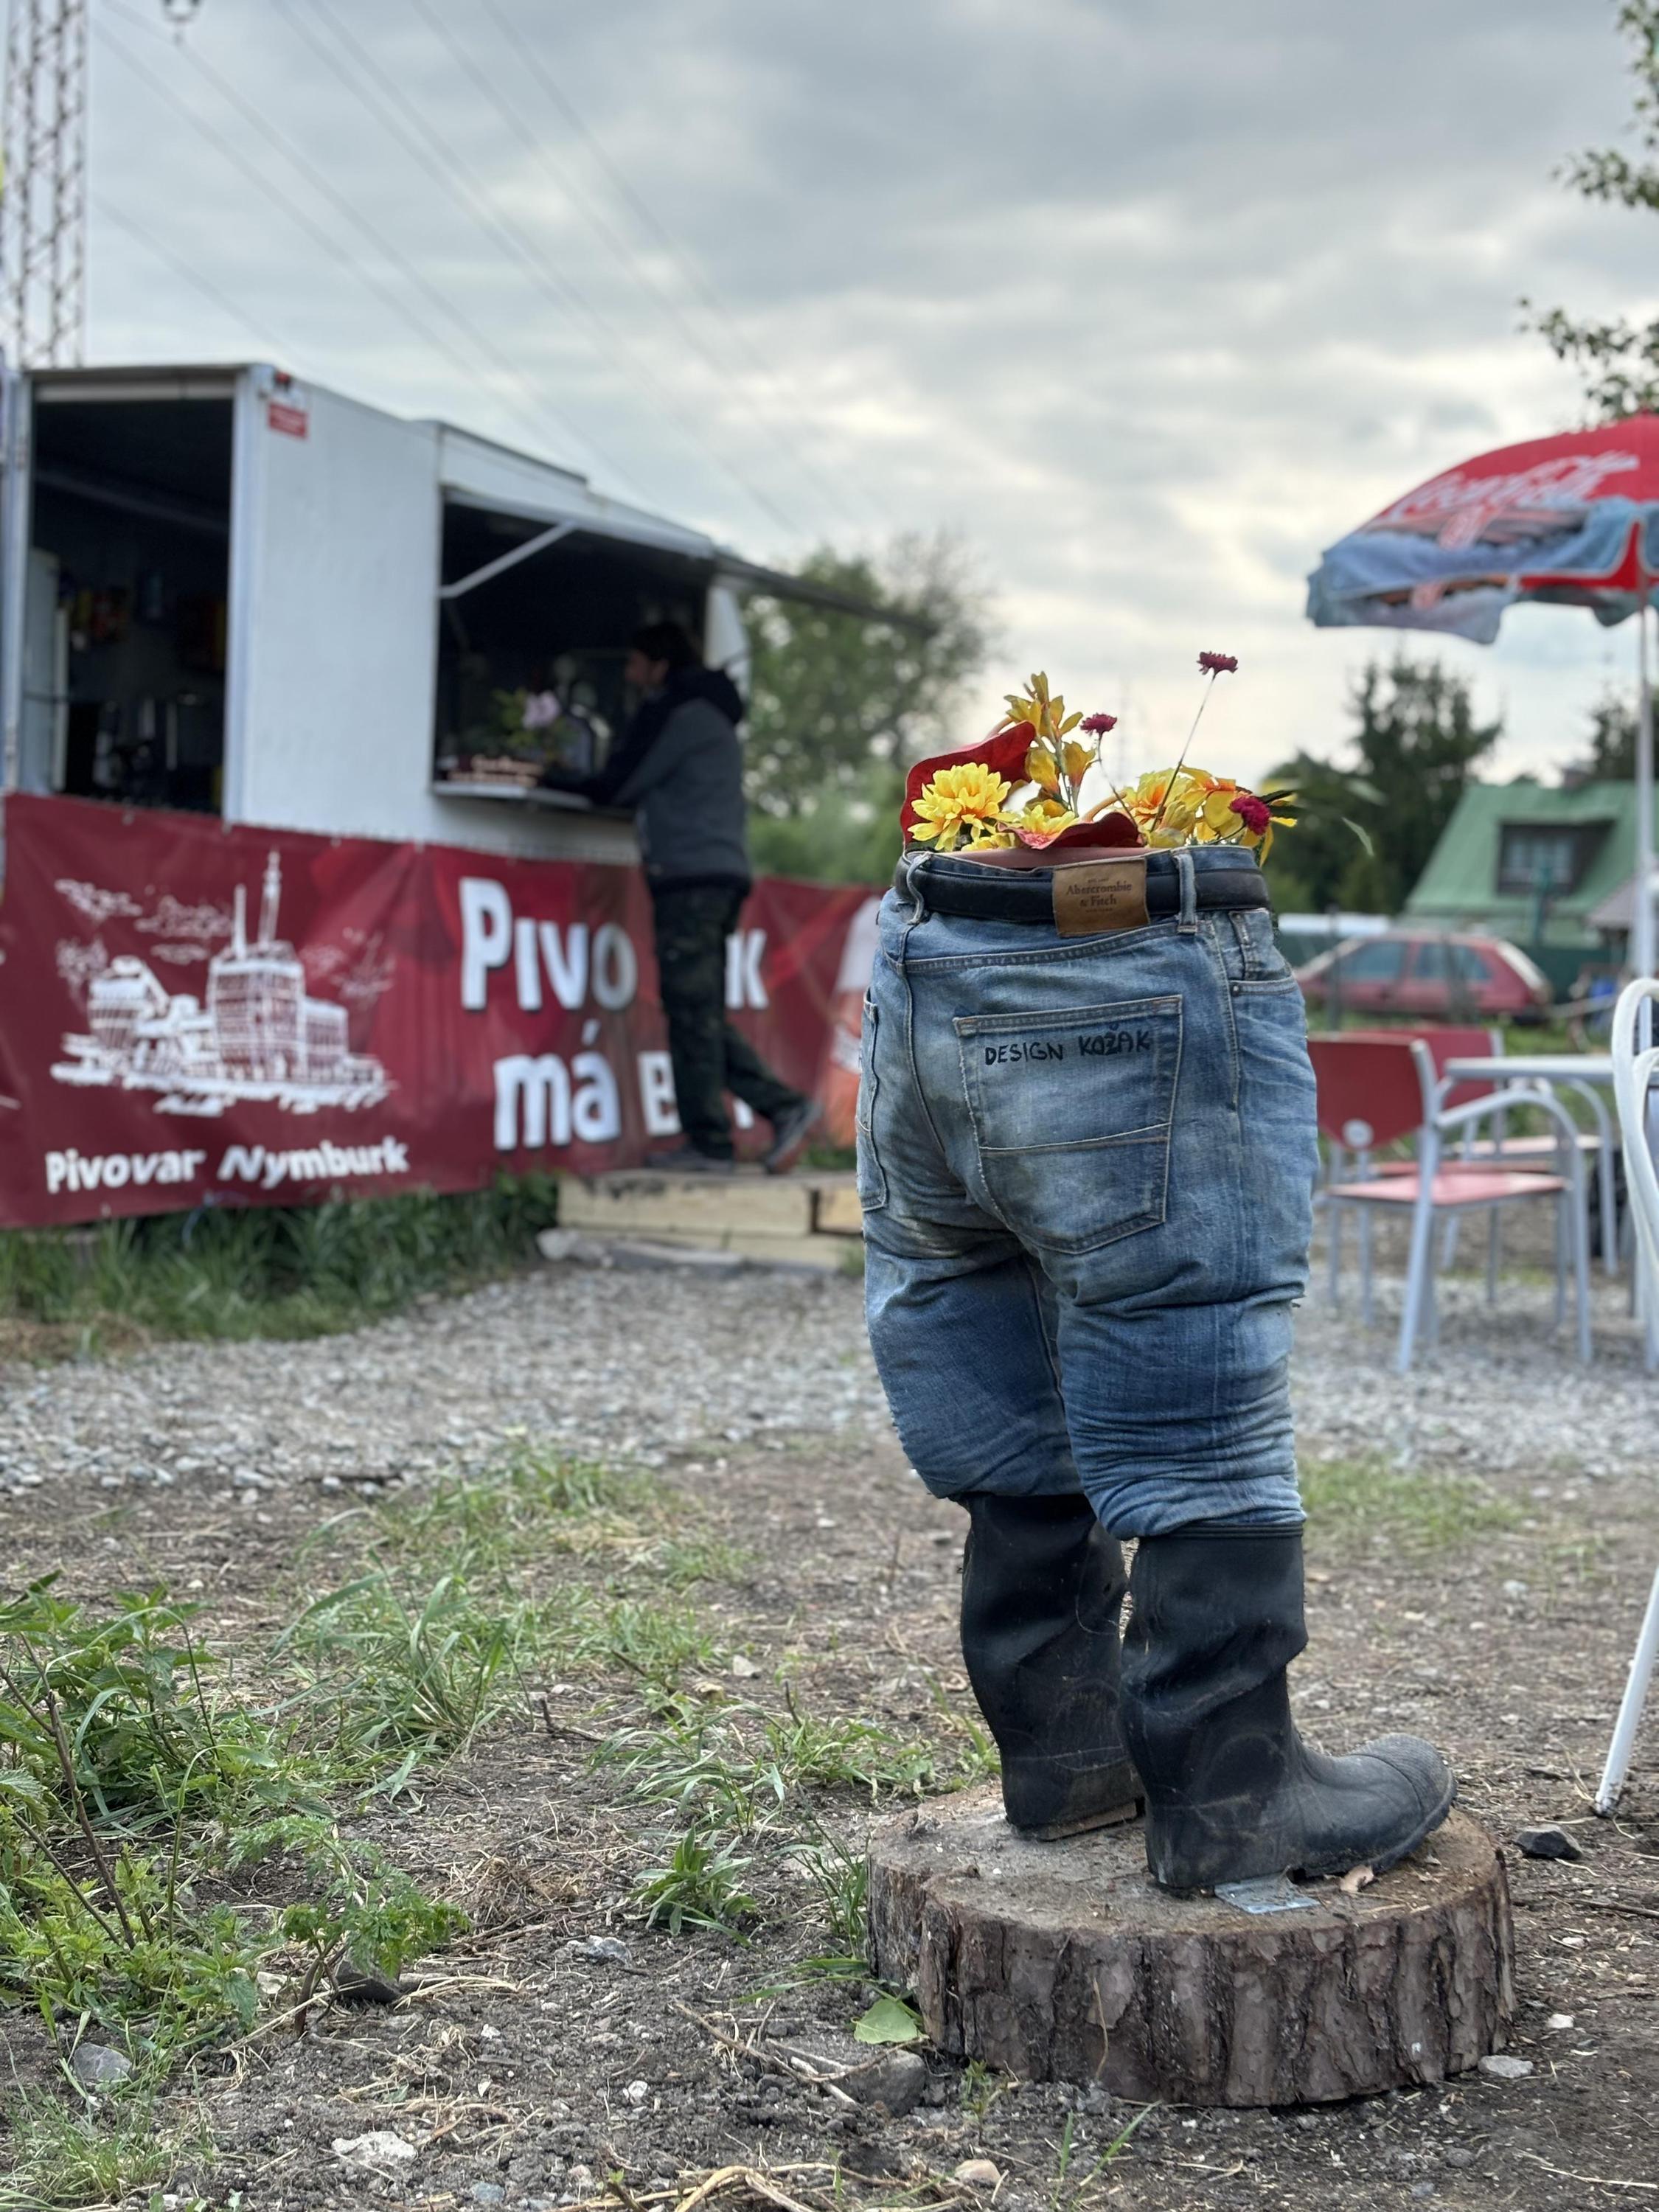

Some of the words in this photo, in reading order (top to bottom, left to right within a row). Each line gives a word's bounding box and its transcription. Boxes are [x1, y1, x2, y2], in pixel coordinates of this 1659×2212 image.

[984, 1042, 1064, 1065] DESIGN
[493, 1019, 621, 1150] má
[45, 1147, 206, 1194] Pivovar
[217, 1135, 410, 1189] Nymburk
